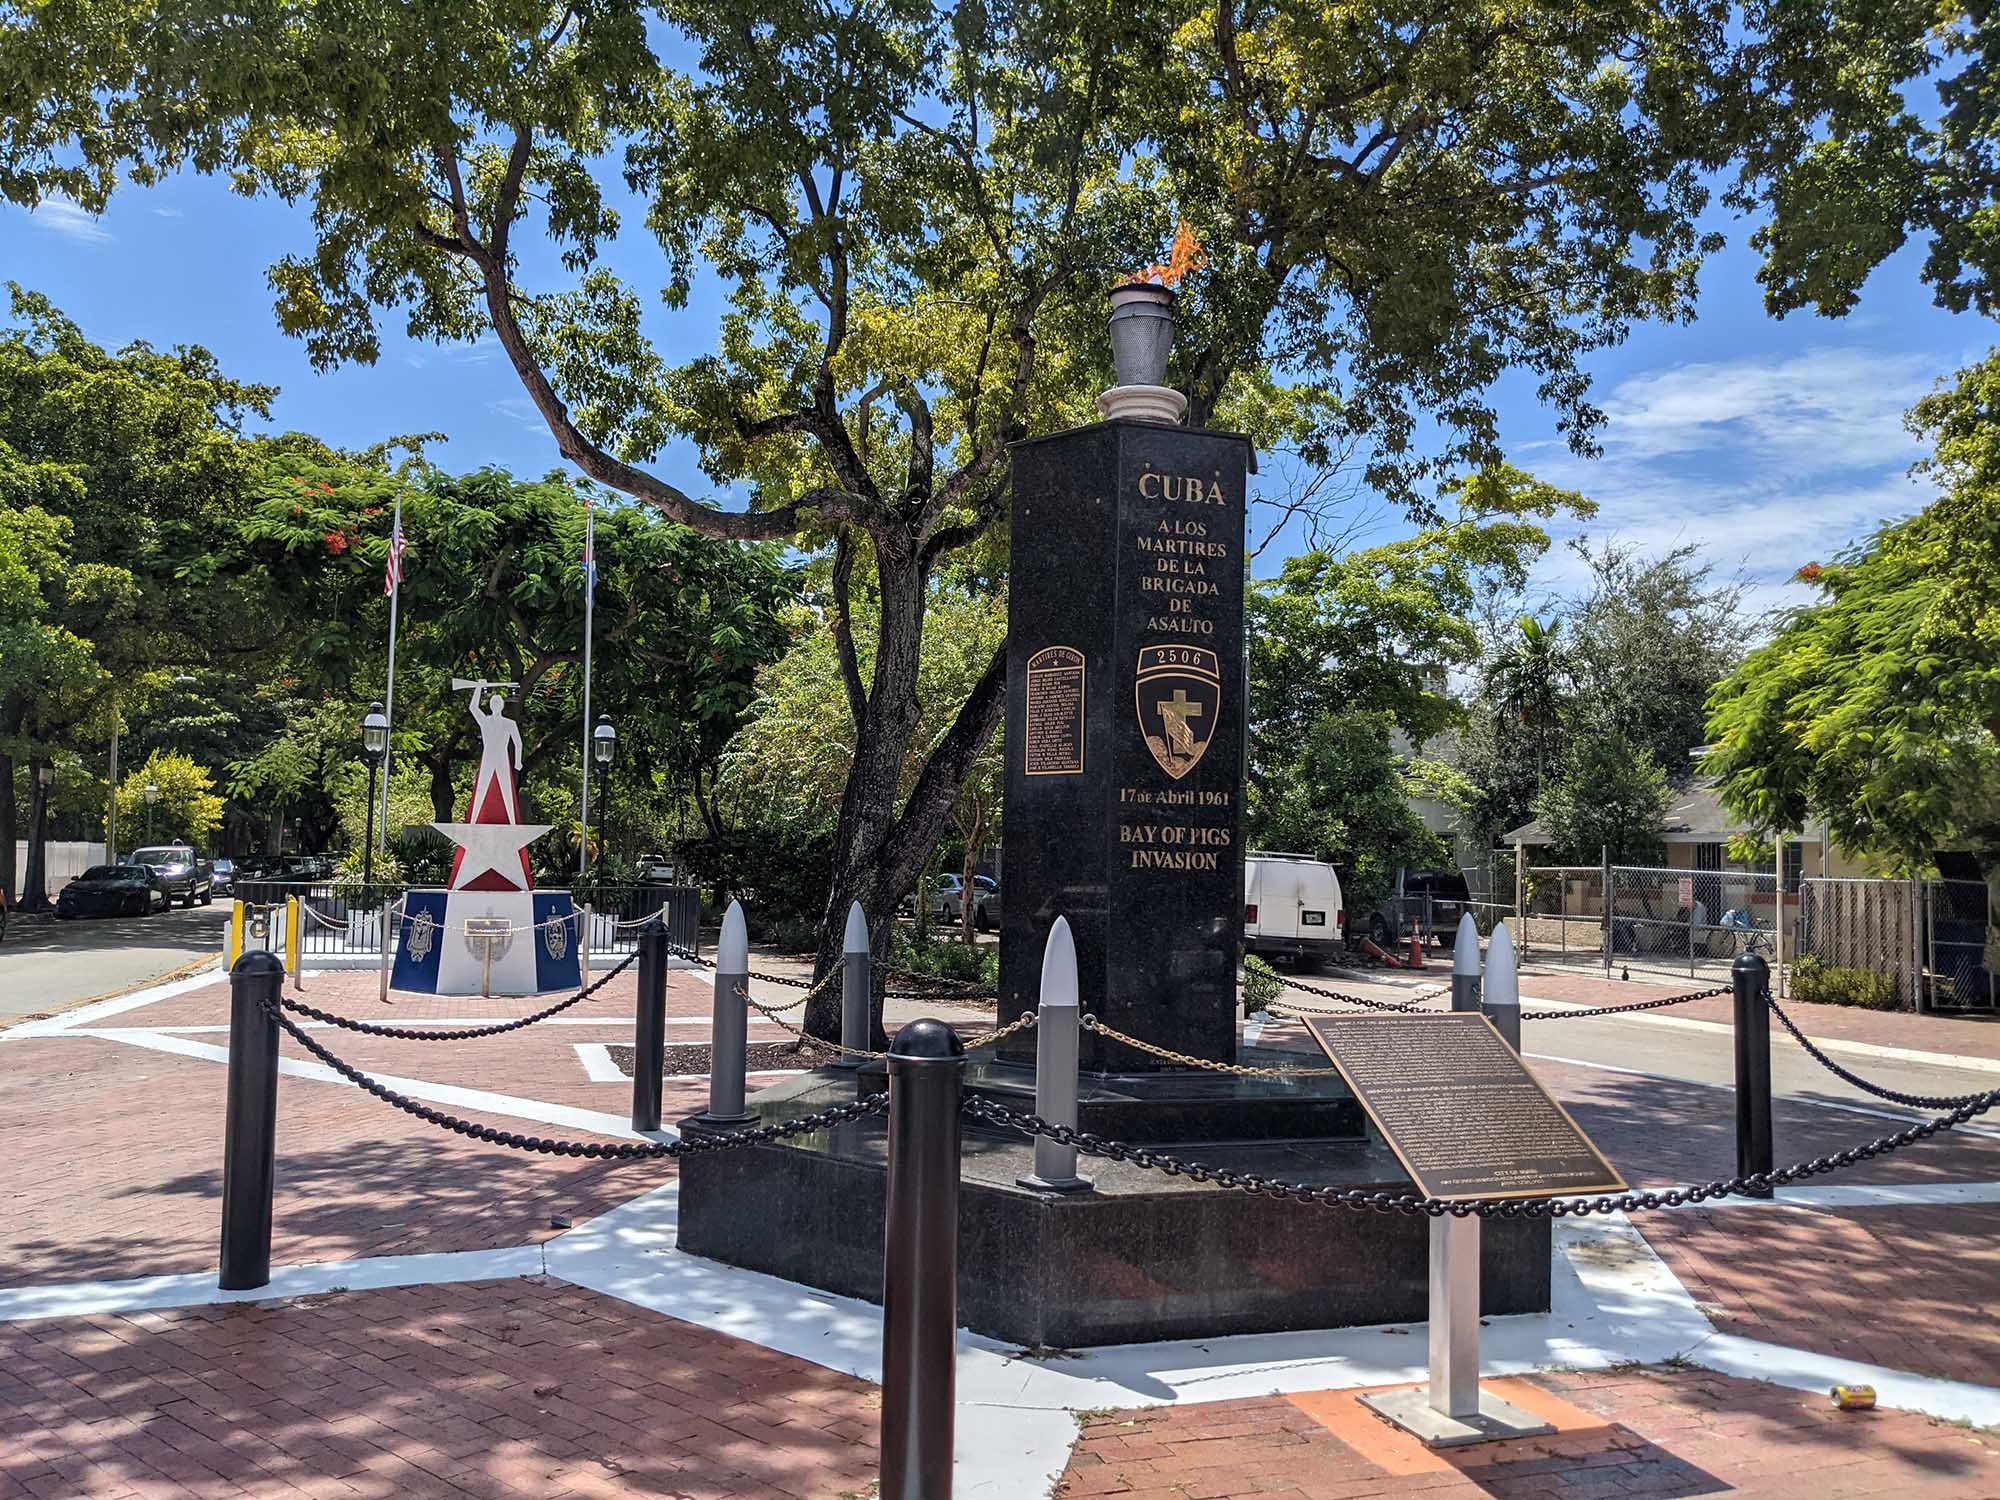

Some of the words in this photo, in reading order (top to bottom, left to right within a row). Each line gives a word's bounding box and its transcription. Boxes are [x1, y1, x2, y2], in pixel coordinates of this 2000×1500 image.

[1138, 473, 1226, 506] CUBA
[1158, 520, 1169, 533] A
[1175, 521, 1206, 536] LOS
[1137, 537, 1227, 557] MARTIRES
[1157, 558, 1179, 573] DE
[1184, 560, 1205, 575] LA
[1142, 576, 1219, 596] BRIGADA
[1170, 599, 1192, 613] DE
[1147, 616, 1214, 634] ASALTO
[1157, 650, 1201, 665] 2506
[1120, 788, 1136, 802] 17
[1155, 789, 1194, 804] Abril
[1199, 791, 1229, 806] 1961
[1120, 825, 1157, 843] BAY
[1161, 826, 1186, 844] OF
[1189, 827, 1231, 846] PIGS
[1131, 850, 1217, 870] INVASION
